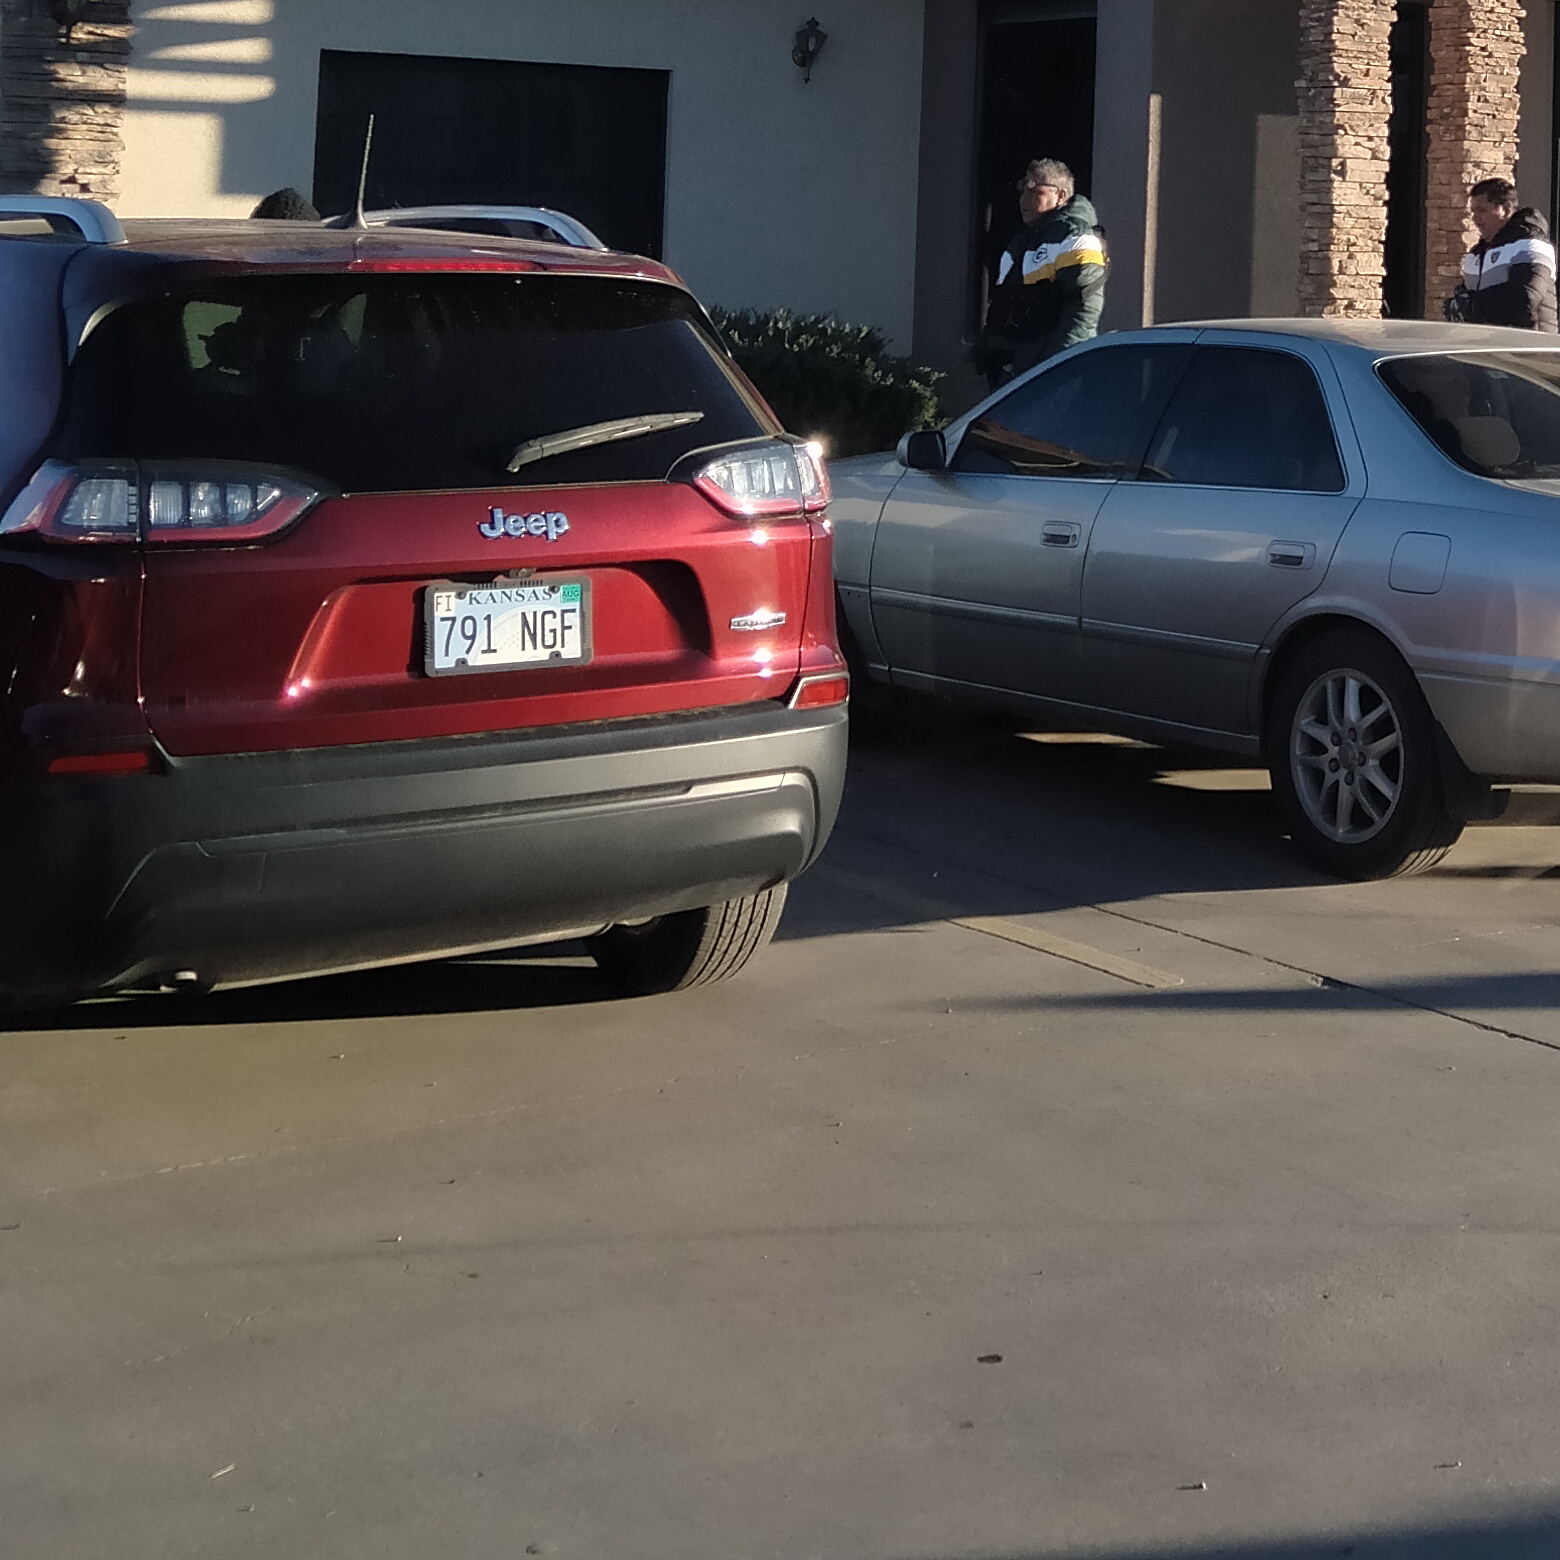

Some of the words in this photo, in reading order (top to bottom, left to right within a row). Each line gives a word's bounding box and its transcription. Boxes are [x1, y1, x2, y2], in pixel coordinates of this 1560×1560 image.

[477, 506, 570, 541] Jeep
[468, 588, 553, 606] KANSAS
[561, 589, 580, 598] AUG
[439, 613, 498, 658] 791
[520, 608, 577, 652] NGF
